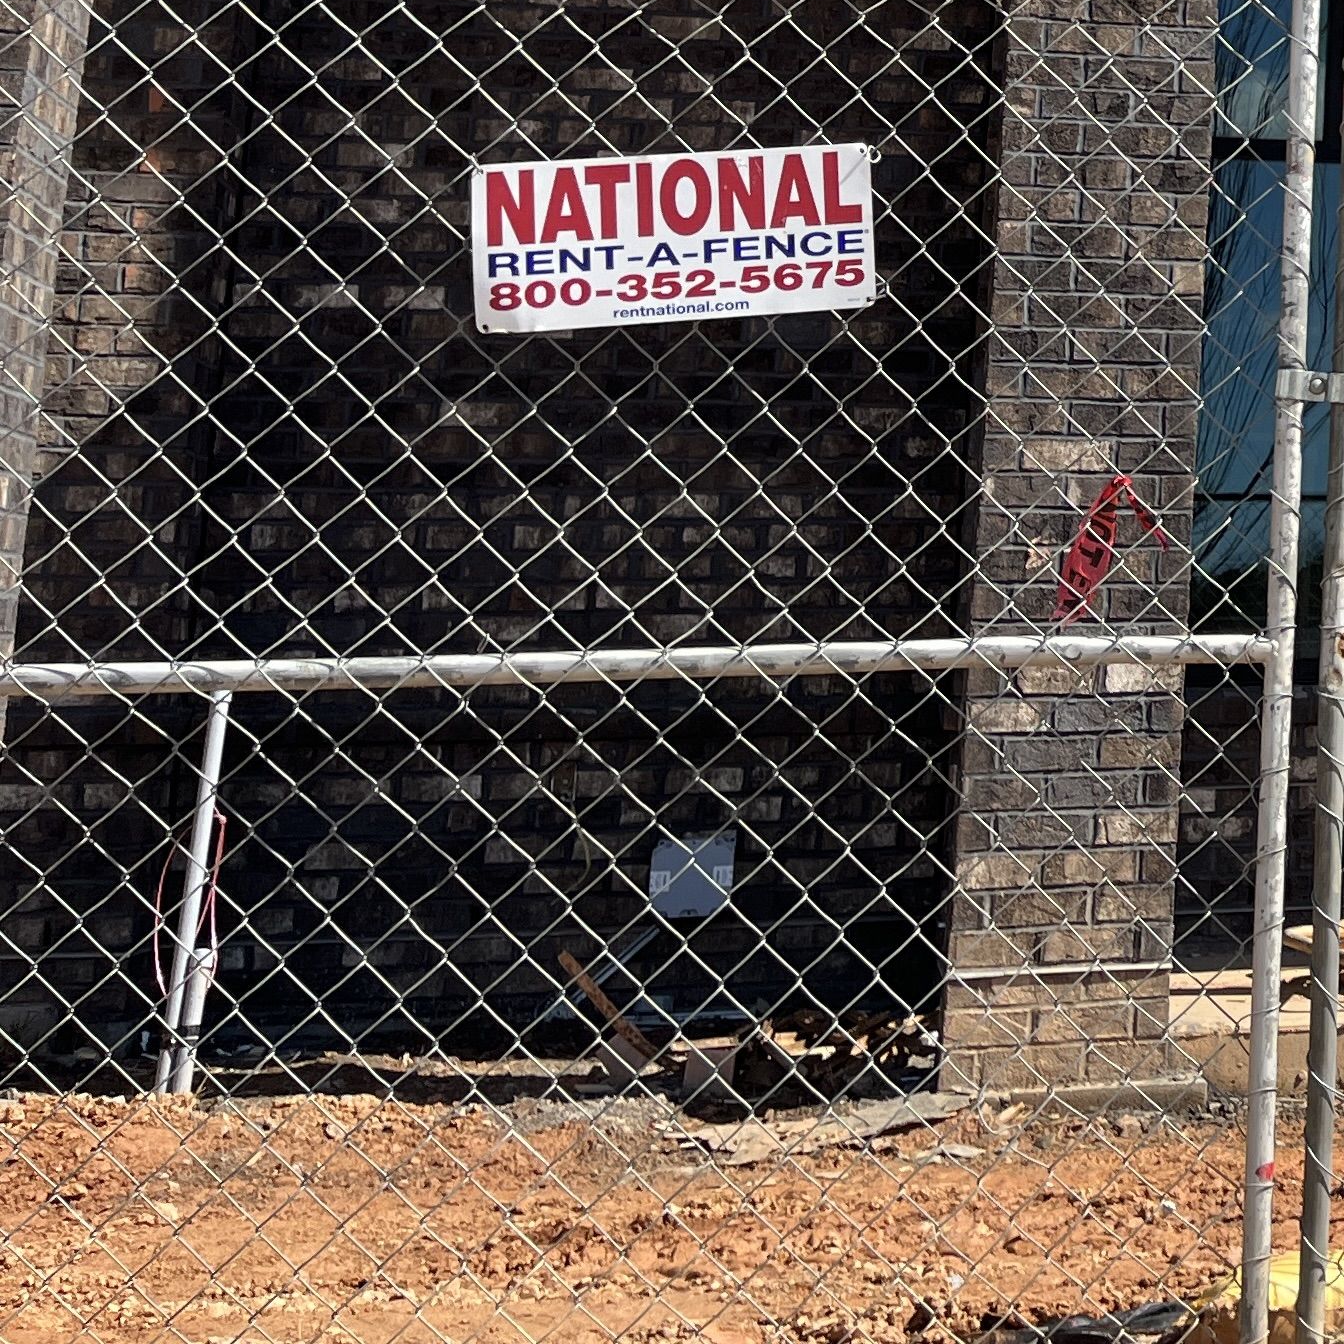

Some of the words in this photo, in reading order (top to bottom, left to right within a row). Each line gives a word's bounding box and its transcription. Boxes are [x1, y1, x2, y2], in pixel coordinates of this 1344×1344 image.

[486, 151, 863, 247] NATIONAL
[488, 229, 866, 278] RENT-A-FENCE
[489, 258, 866, 311] 800-352-5675
[612, 300, 750, 318] rentnational.com
